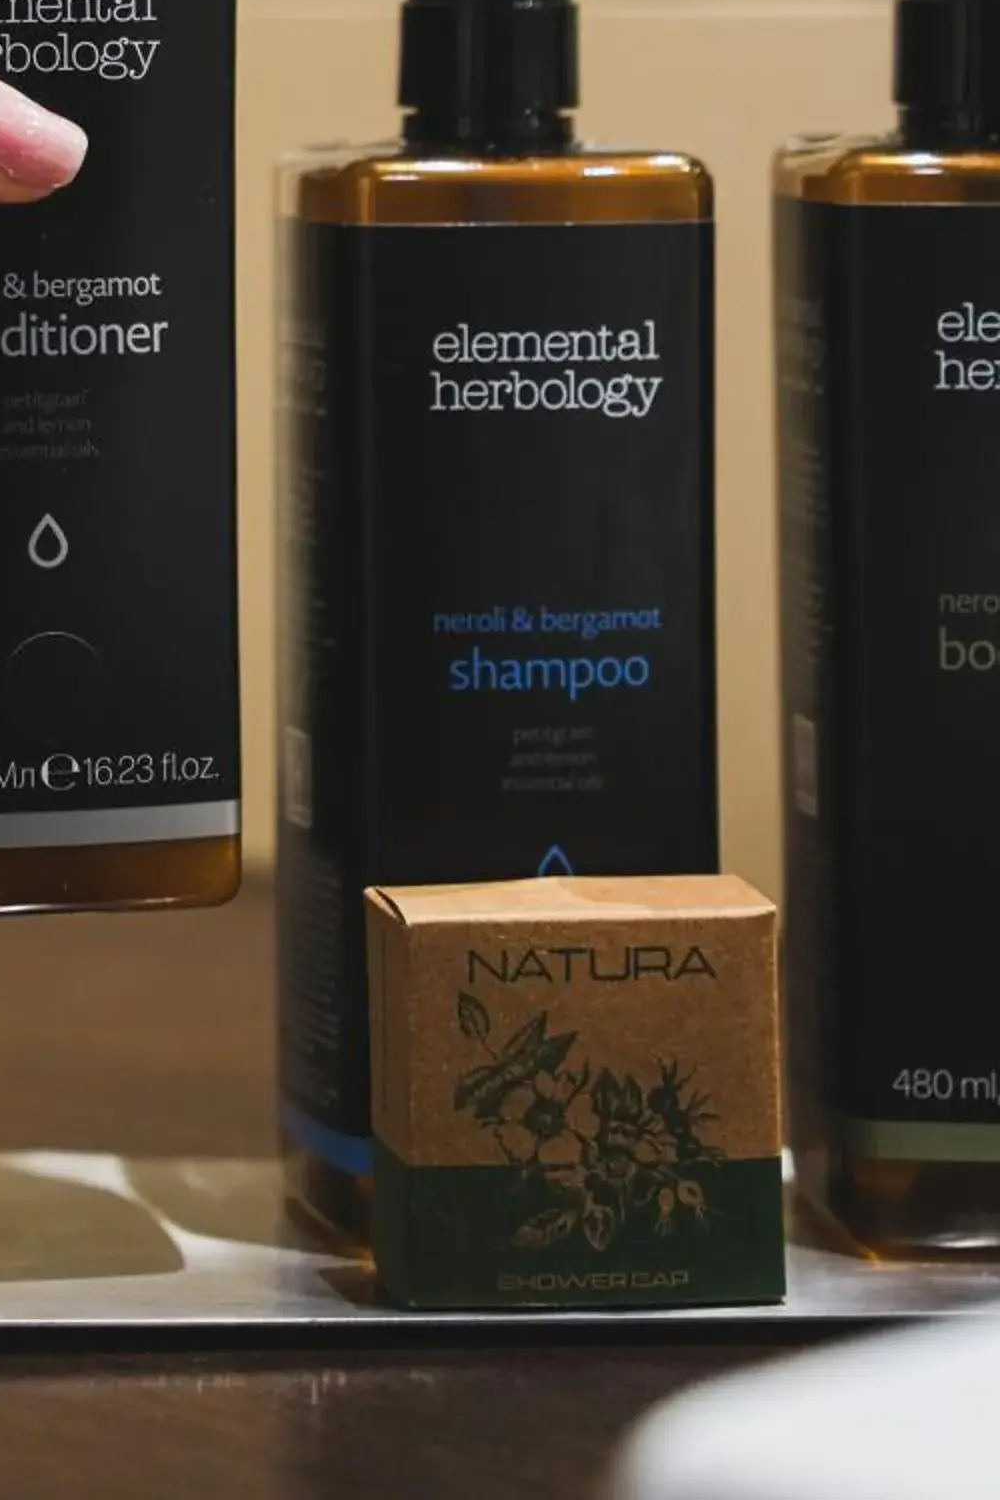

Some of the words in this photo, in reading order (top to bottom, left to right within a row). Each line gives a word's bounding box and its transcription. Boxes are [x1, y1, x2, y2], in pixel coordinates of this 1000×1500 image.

[3, 272, 27, 299] &
[33, 270, 162, 306] bergamot
[432, 319, 661, 364] elemental
[429, 369, 664, 418] herbology
[434, 606, 506, 632] neroli
[511, 607, 534, 632] &
[539, 606, 662, 638] bergamot
[939, 625, 1000, 671] bo
[450, 646, 650, 702] shampoo
[84, 753, 155, 787] 16.23
[467, 946, 717, 984] NATURA
[892, 1068, 954, 1100] 480
